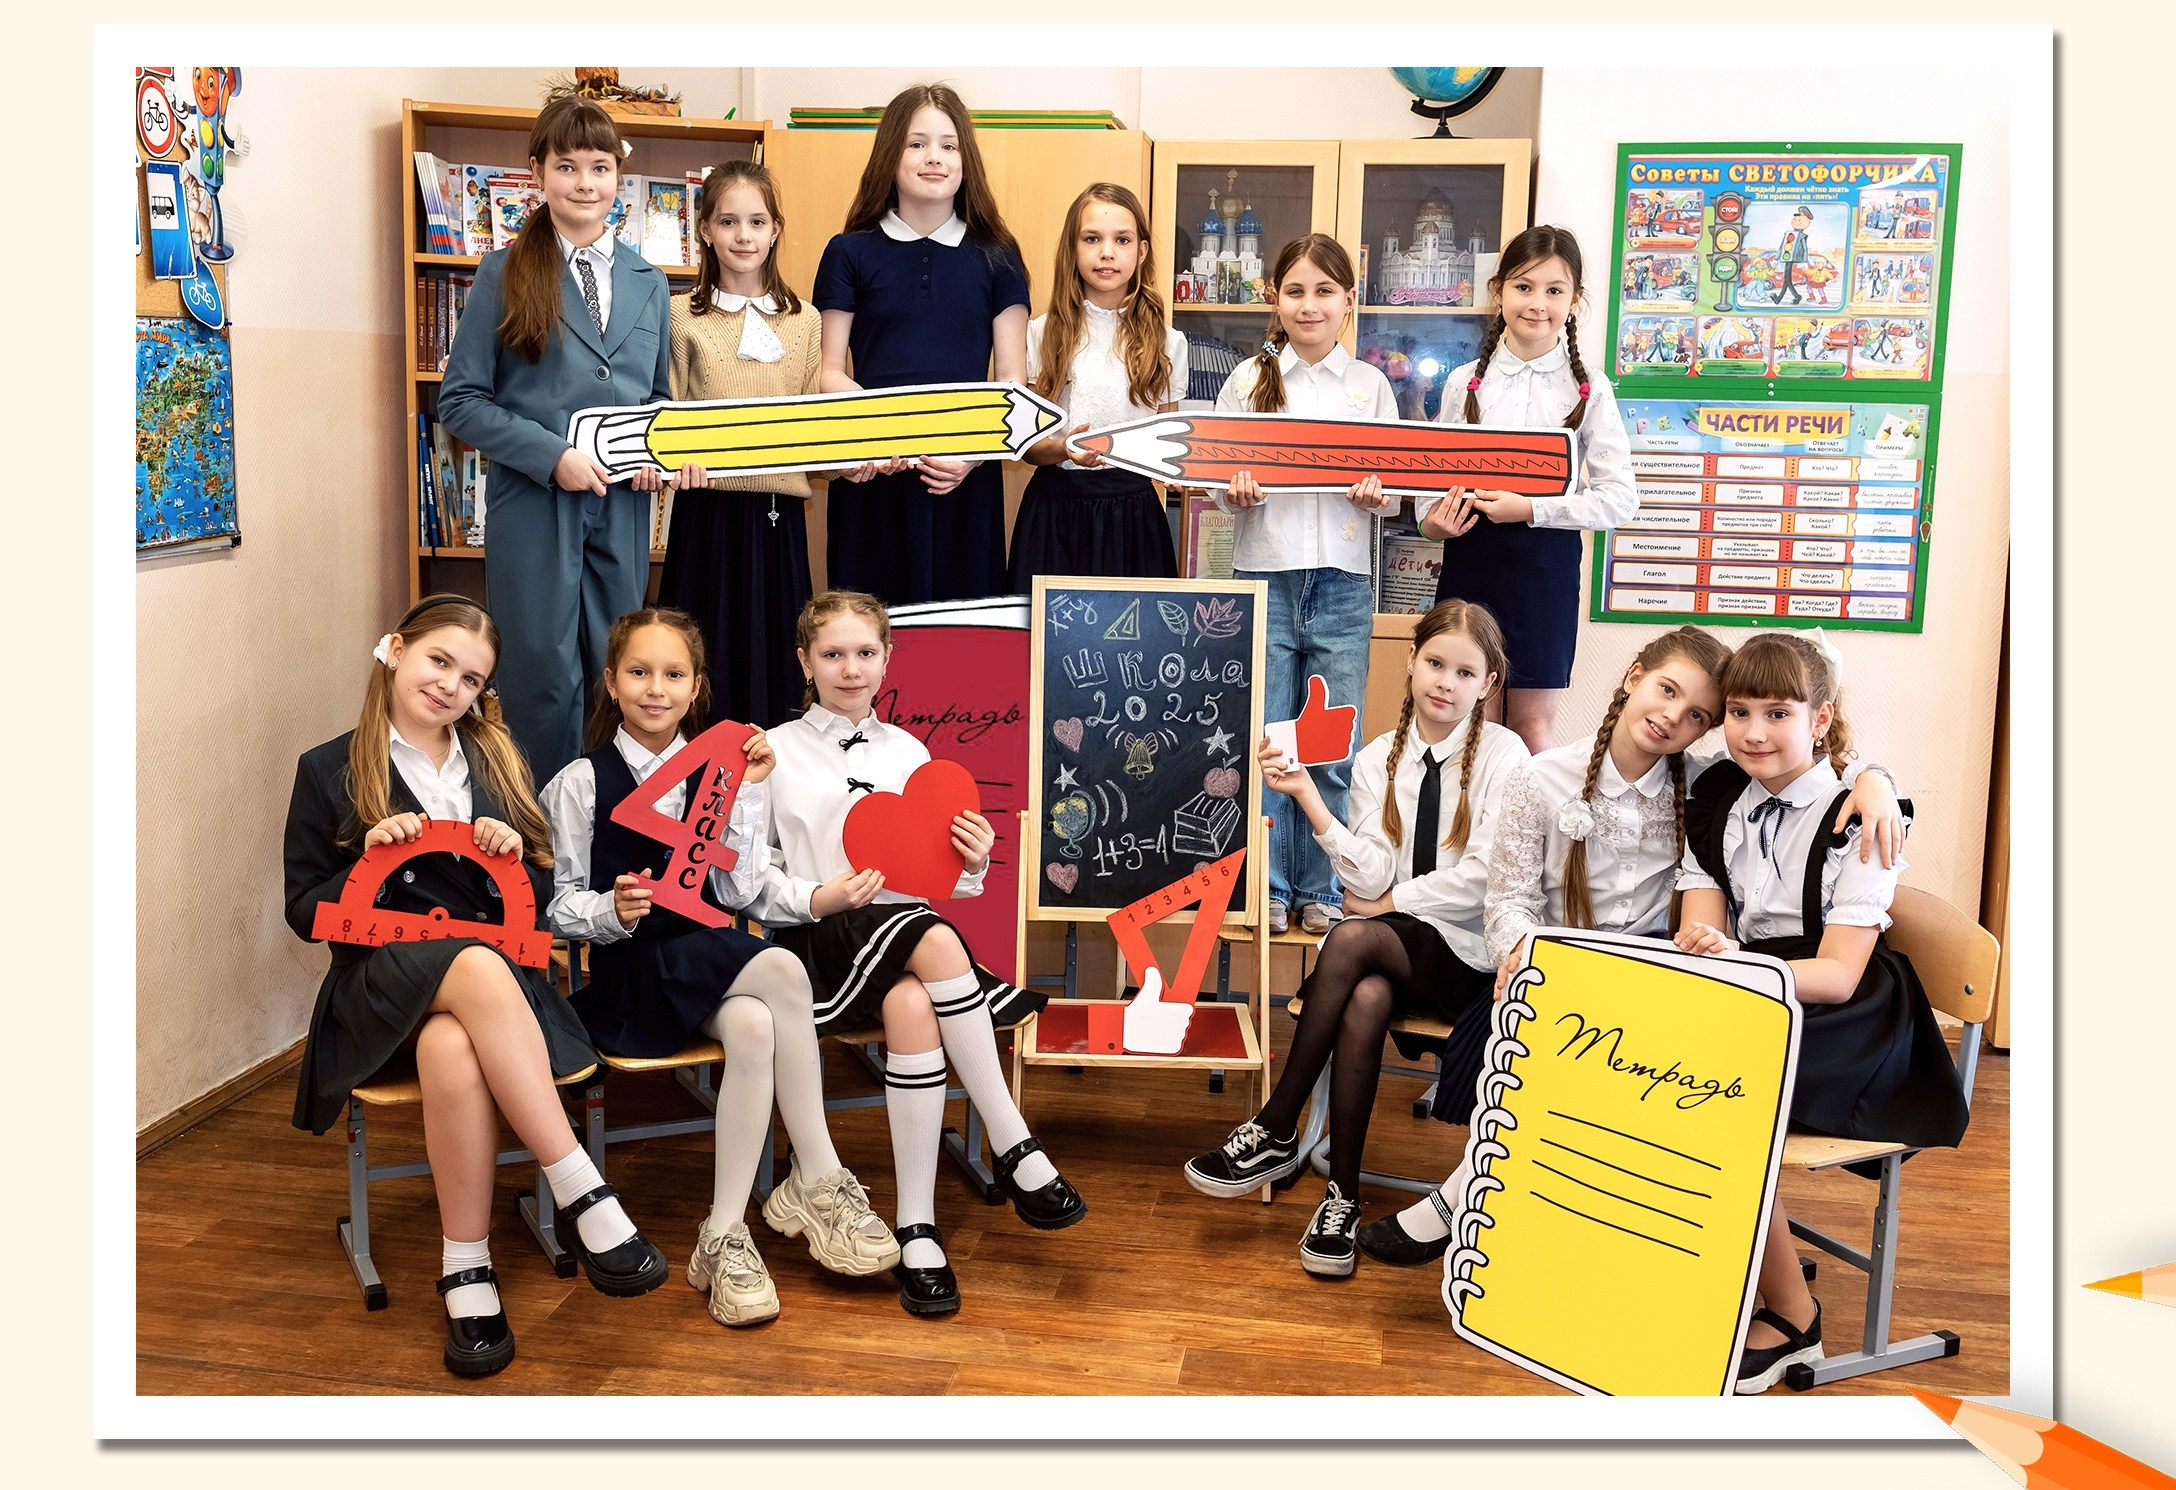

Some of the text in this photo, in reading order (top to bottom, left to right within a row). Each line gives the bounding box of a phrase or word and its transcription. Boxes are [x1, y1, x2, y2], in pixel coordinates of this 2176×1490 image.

[1630, 163, 1721, 183] Советы
[1745, 185, 1775, 193] Каждый
[1706, 413, 1843, 435] ЧАСТИ РЕЧИ
[1632, 543, 1682, 551] Местоимение
[1638, 597, 1668, 605] Наречие
[1085, 689, 1223, 728] 2025
[1127, 866, 1230, 923] 1 2 3 4 5 6
[342, 918, 353, 933] 8
[367, 922, 377, 936] 7
[394, 926, 404, 939] 6
[419, 929, 430, 941] 5
[495, 939, 504, 951] 2
[519, 942, 525, 956] 1
[1555, 1012, 1746, 1110] Тетрадь
